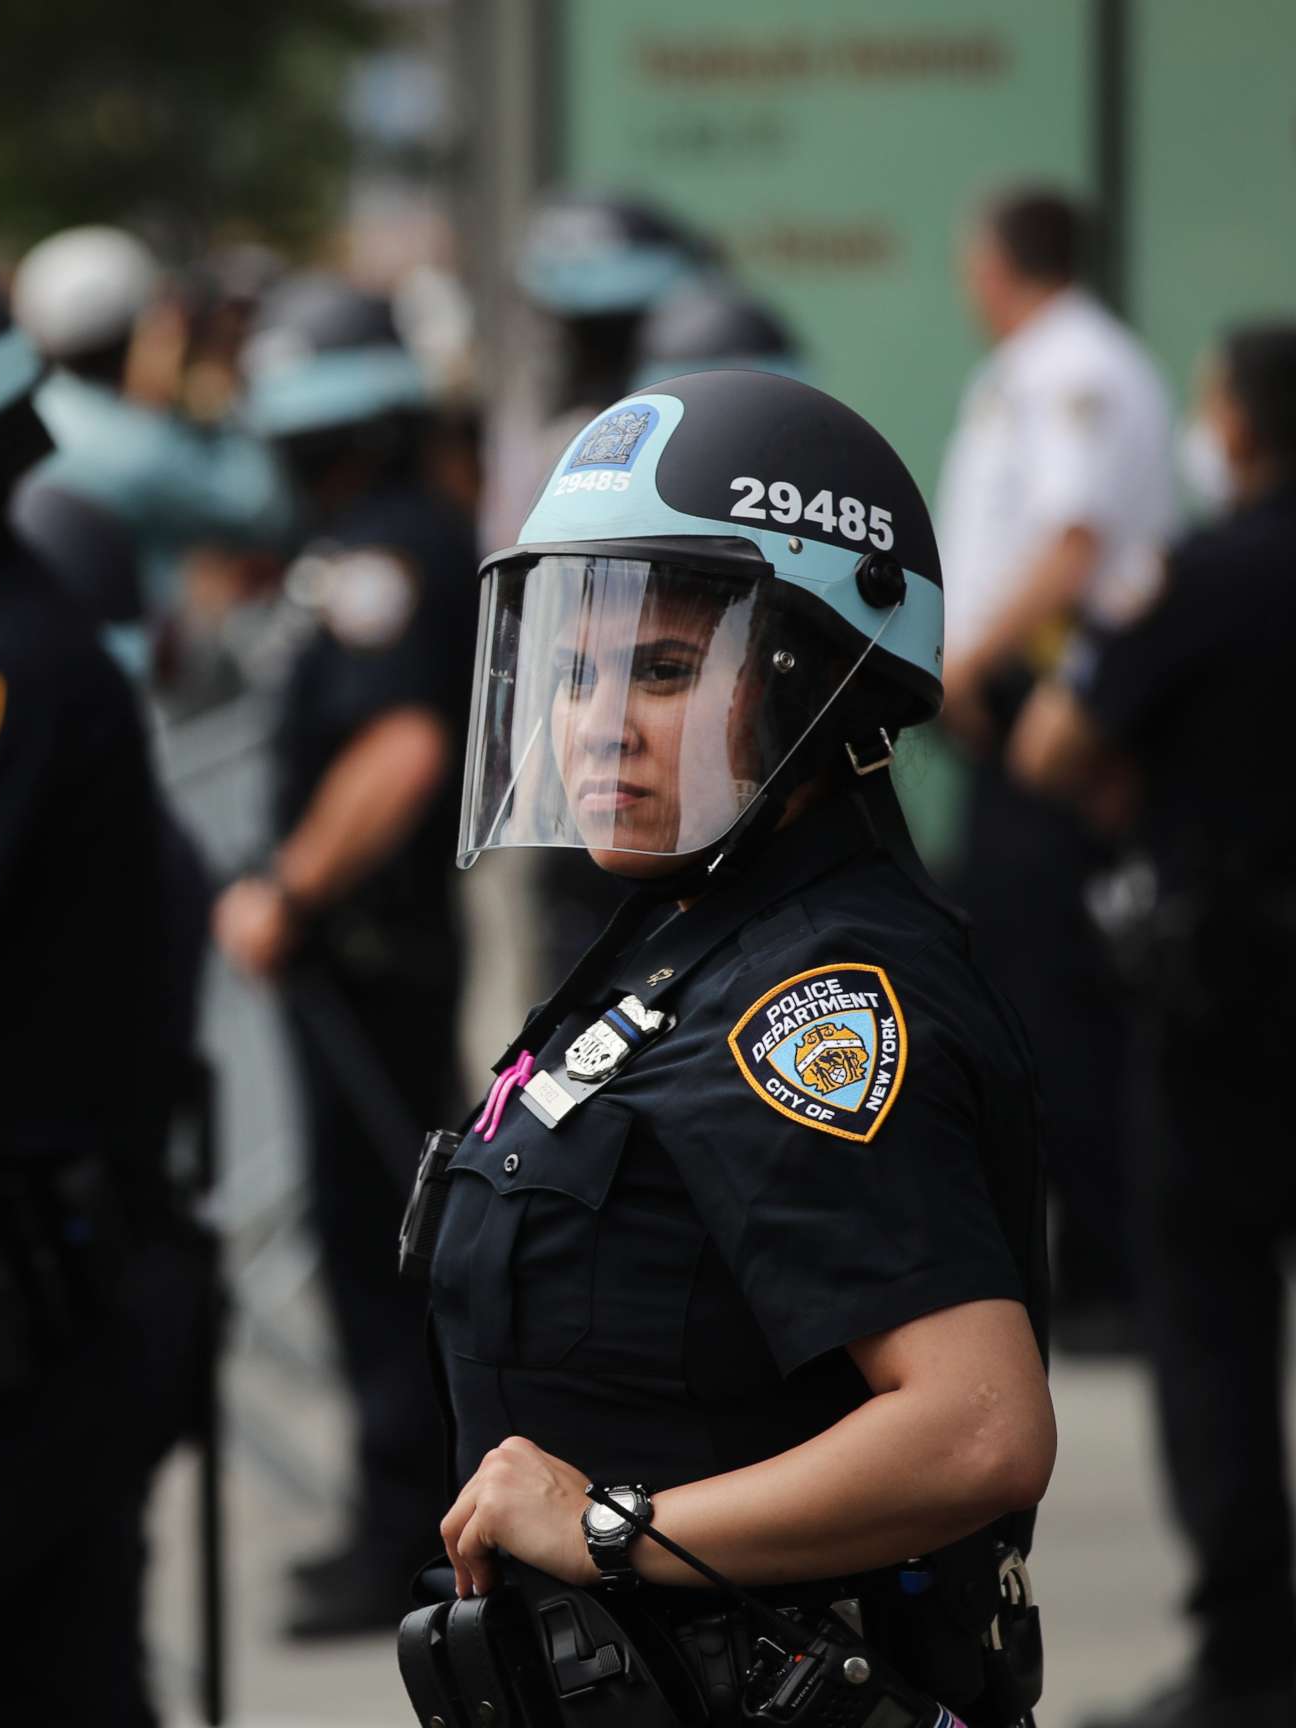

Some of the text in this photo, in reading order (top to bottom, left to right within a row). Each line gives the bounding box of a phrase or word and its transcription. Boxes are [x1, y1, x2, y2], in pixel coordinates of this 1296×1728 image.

[554, 471, 633, 497] 29485
[729, 476, 895, 551] 29485
[752, 992, 879, 1063] DEPARTMENT
[766, 979, 843, 1026] POLICE
[865, 1016, 896, 1112] NEW YORK
[765, 1077, 835, 1122] CITY OF
